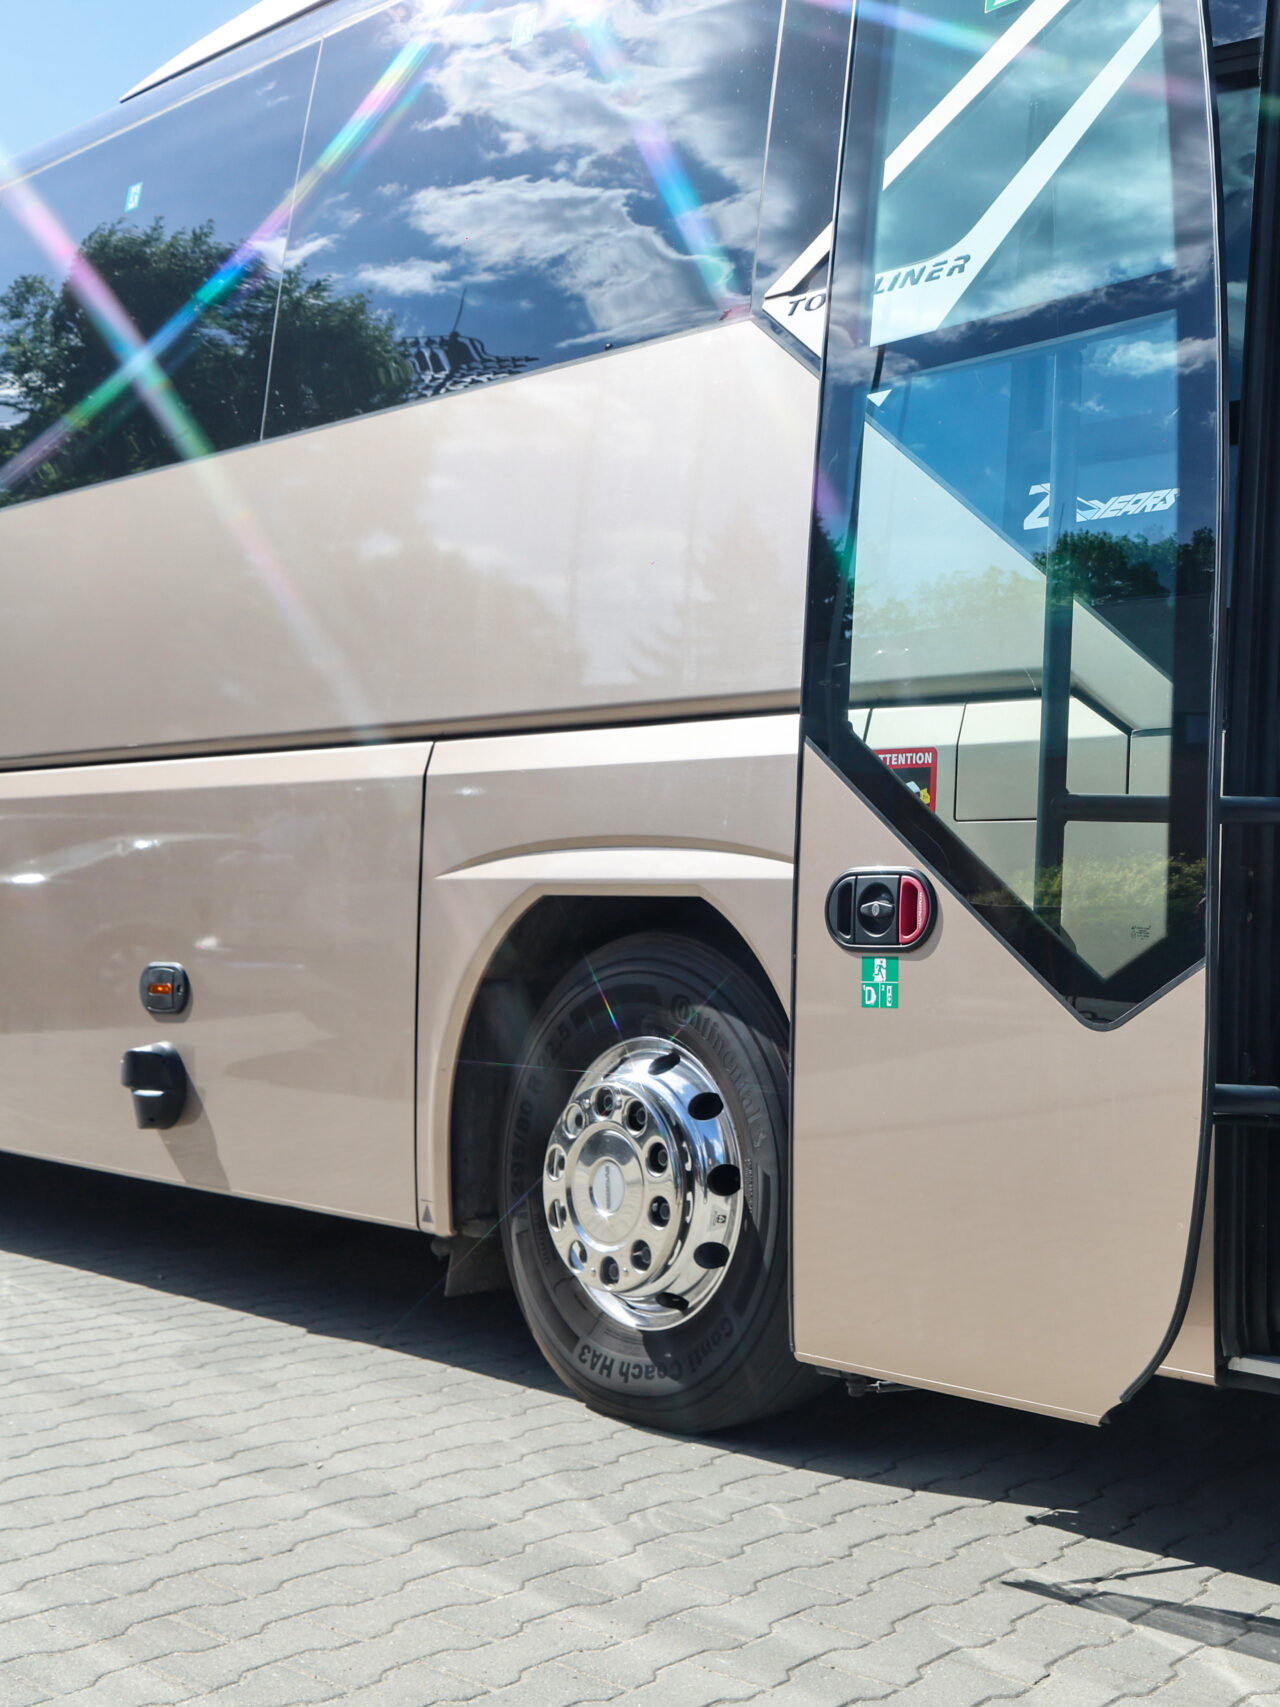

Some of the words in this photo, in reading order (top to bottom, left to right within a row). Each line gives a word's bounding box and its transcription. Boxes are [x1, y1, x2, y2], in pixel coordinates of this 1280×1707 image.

[1089, 488, 1180, 520] YEARS
[878, 752, 933, 766] TTENTION
[687, 1316, 734, 1373] Conti
[578, 1344, 615, 1378] HA3
[618, 1359, 682, 1383] Coach
